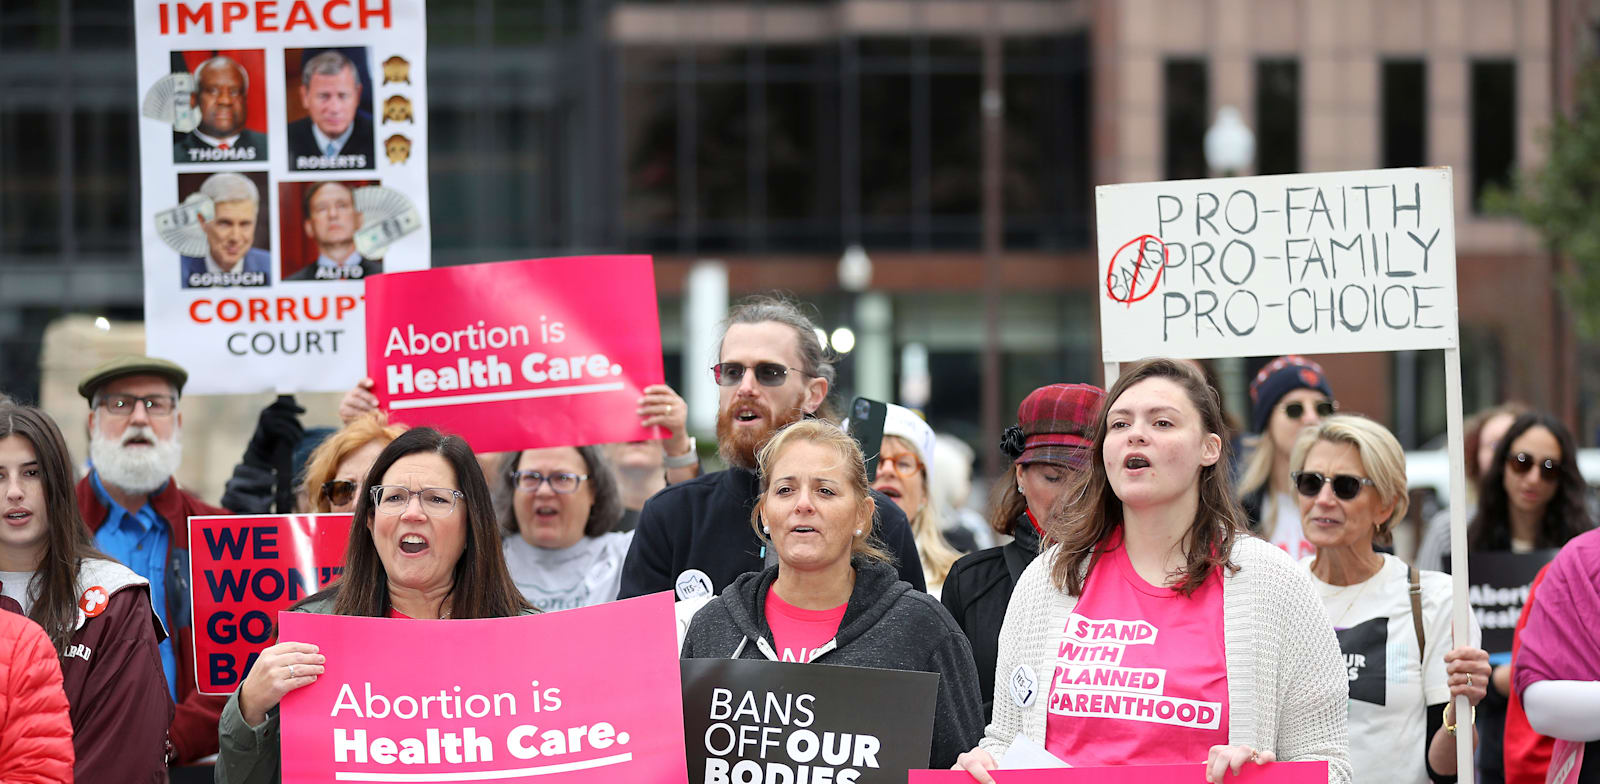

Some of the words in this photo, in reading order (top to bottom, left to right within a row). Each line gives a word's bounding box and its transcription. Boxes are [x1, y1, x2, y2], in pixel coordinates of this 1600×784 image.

[158, 0, 393, 35] IMPEACH
[188, 146, 257, 161] THOMAS
[296, 155, 367, 169] ROBERTS
[1157, 183, 1421, 239] PRO-FAITH
[315, 265, 364, 279] ALITO
[1105, 240, 1164, 303] BANS
[1162, 228, 1440, 285] PRO-FAMILY
[189, 272, 265, 287] GORSUCH
[189, 296, 366, 324] CORRUP
[1163, 284, 1446, 341] PRO-CHOICE
[227, 329, 345, 356] COURT
[384, 320, 529, 358] Abortion
[540, 314, 566, 344] is
[386, 354, 513, 395] Health
[521, 352, 623, 384] Care.
[203, 526, 279, 561] WE
[204, 566, 344, 603] WON'
[207, 610, 272, 645] GO
[1074, 620, 1153, 641] STAND
[1057, 641, 1120, 663] WITH
[1342, 653, 1366, 668] UR
[1055, 666, 1160, 690] PLANNED
[330, 682, 516, 719] Abortion
[531, 680, 562, 713] is
[709, 688, 816, 728] BANS
[1050, 693, 1215, 724] PARENTHOOD
[333, 727, 493, 765] Health
[506, 721, 630, 760] Care.
[704, 722, 783, 759] OFF
[786, 729, 881, 769] OUR
